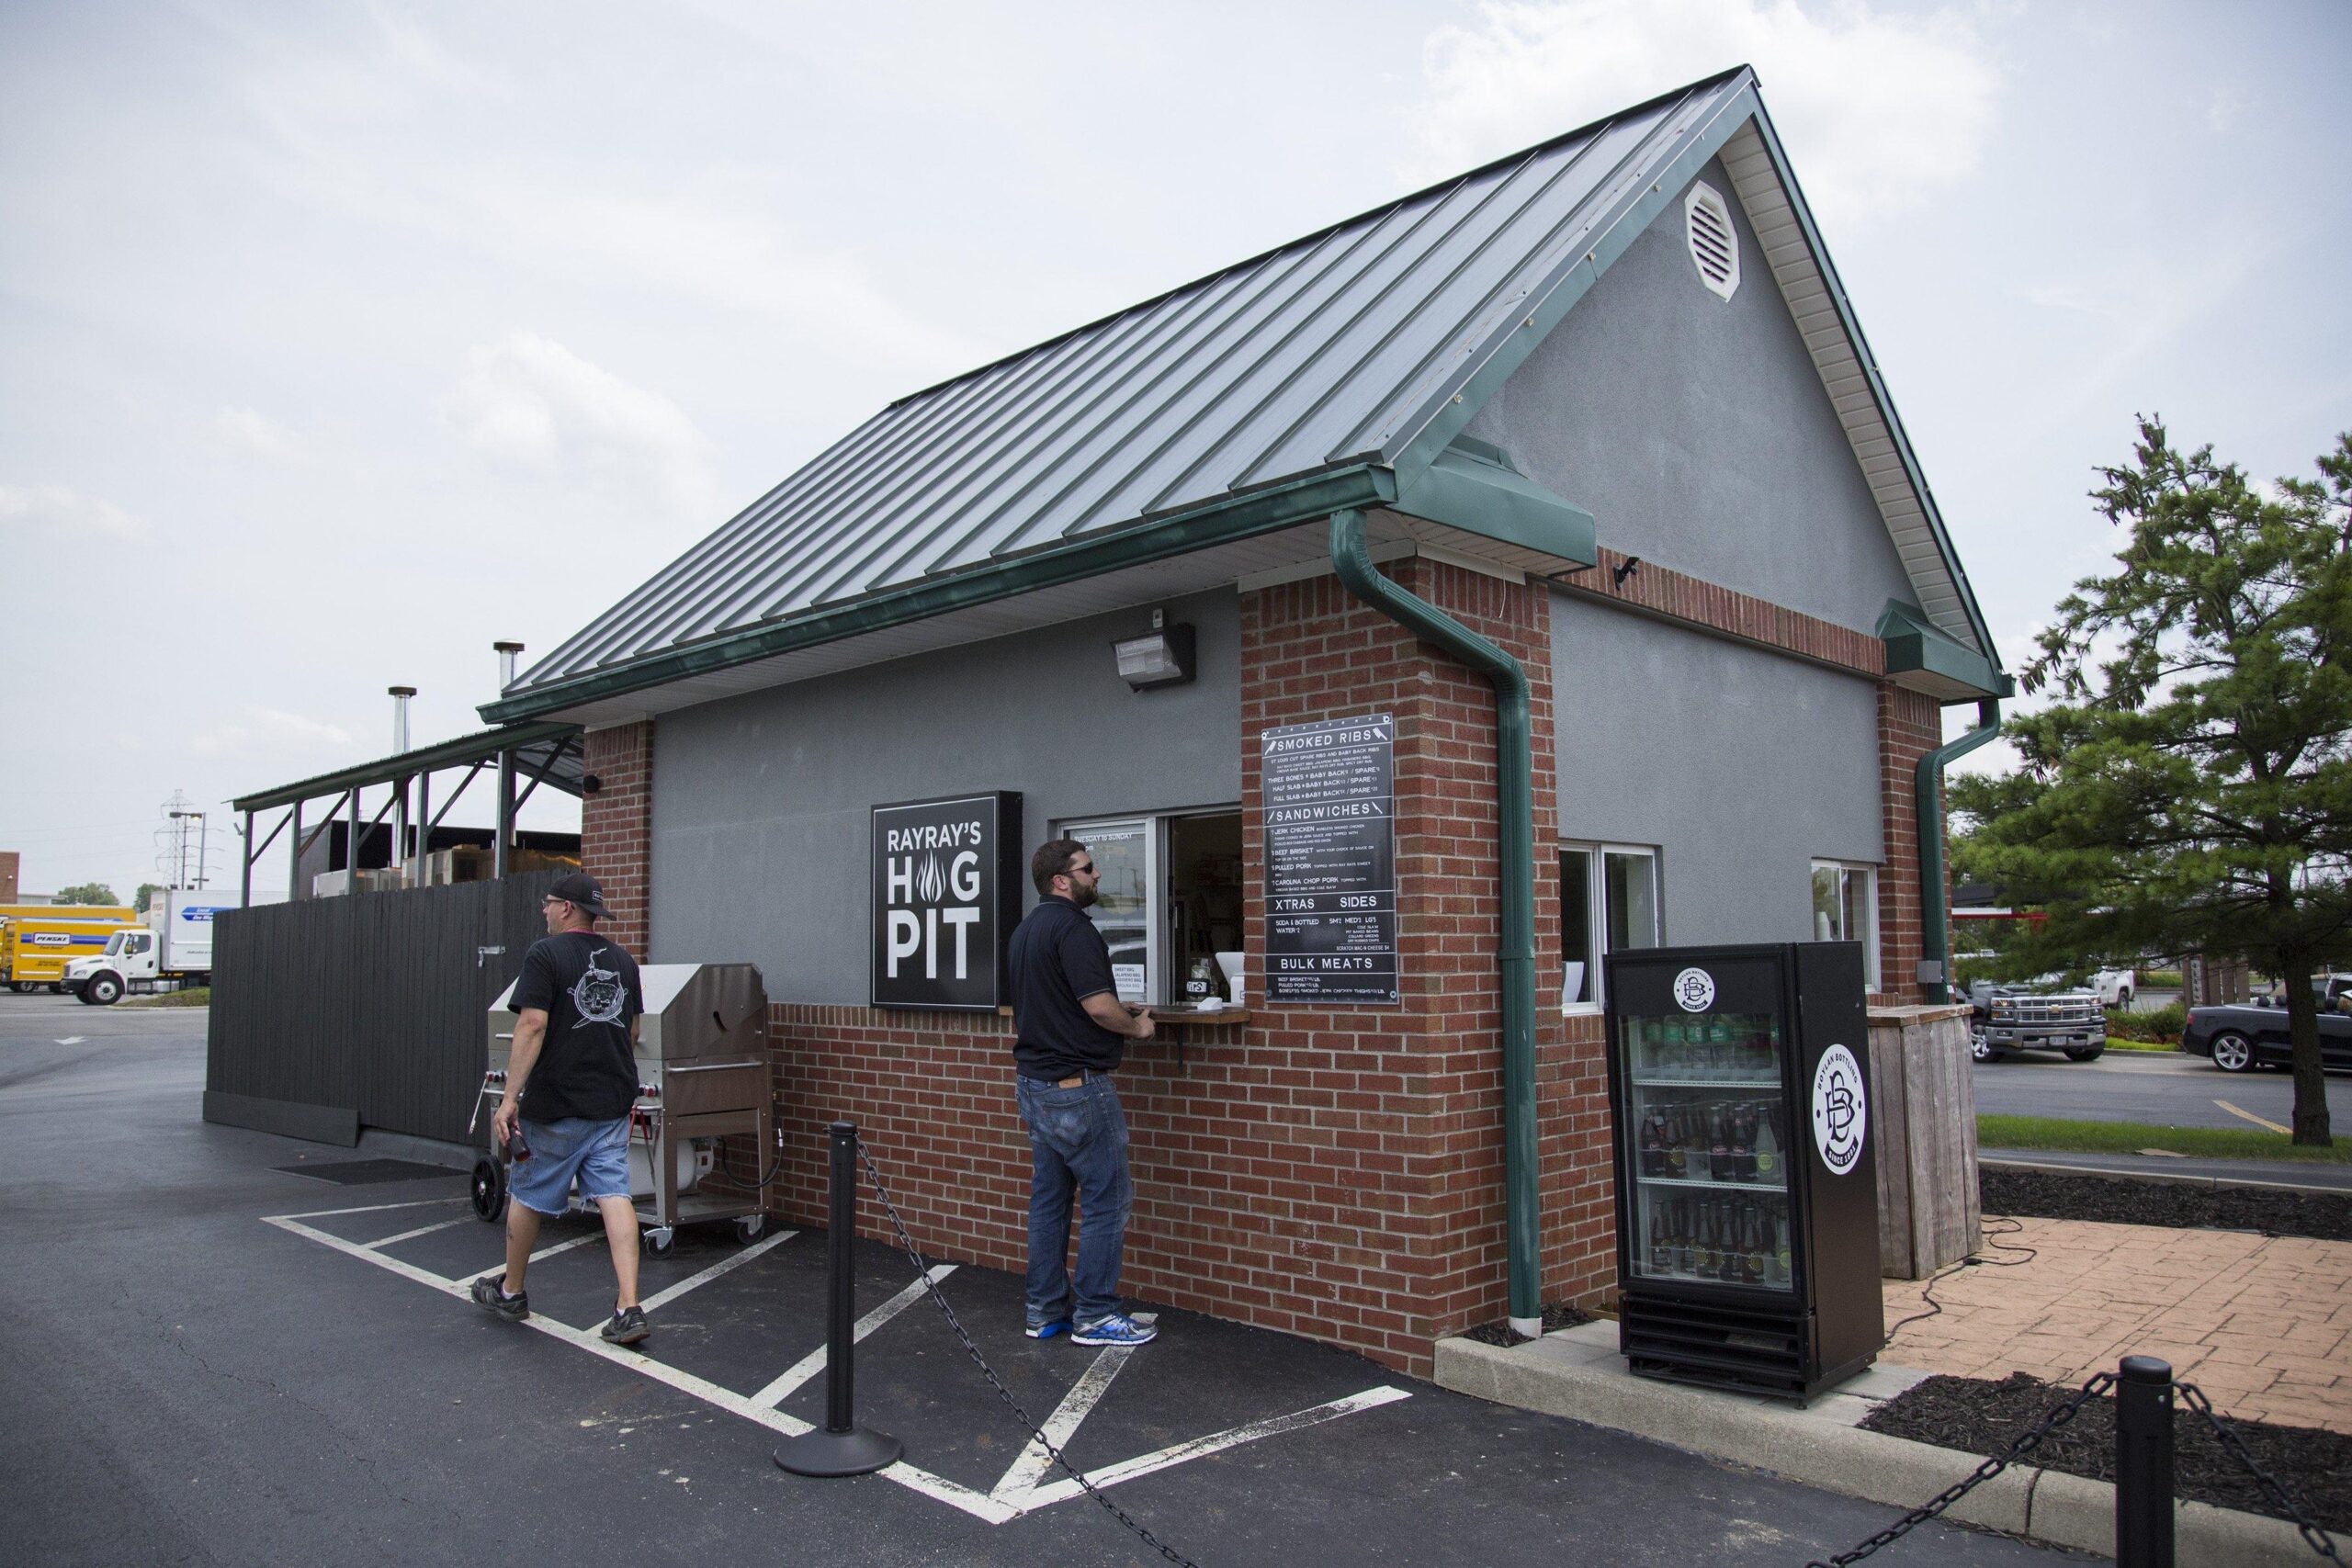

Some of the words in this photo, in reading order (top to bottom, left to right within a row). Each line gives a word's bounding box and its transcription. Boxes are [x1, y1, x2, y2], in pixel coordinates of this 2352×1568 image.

[1277, 735, 1332, 751] SMOKED
[1340, 729, 1372, 743] RIBS
[1276, 803, 1370, 821] SANDWICHES
[888, 821, 981, 852] RAYRAY'S
[1074, 835, 1101, 843] TUESDAY
[1108, 832, 1133, 840] SUNDAY
[1275, 898, 1315, 910] XTRAS
[1340, 896, 1377, 908] SIDES
[888, 907, 980, 979] PIT
[1281, 958, 1315, 969] BULK
[1322, 957, 1373, 969] MEATS
[1817, 1055, 1834, 1090] BOYLAN
[1836, 1053, 1858, 1084] BOTTLING
[1828, 1150, 1843, 1165] SINCE
